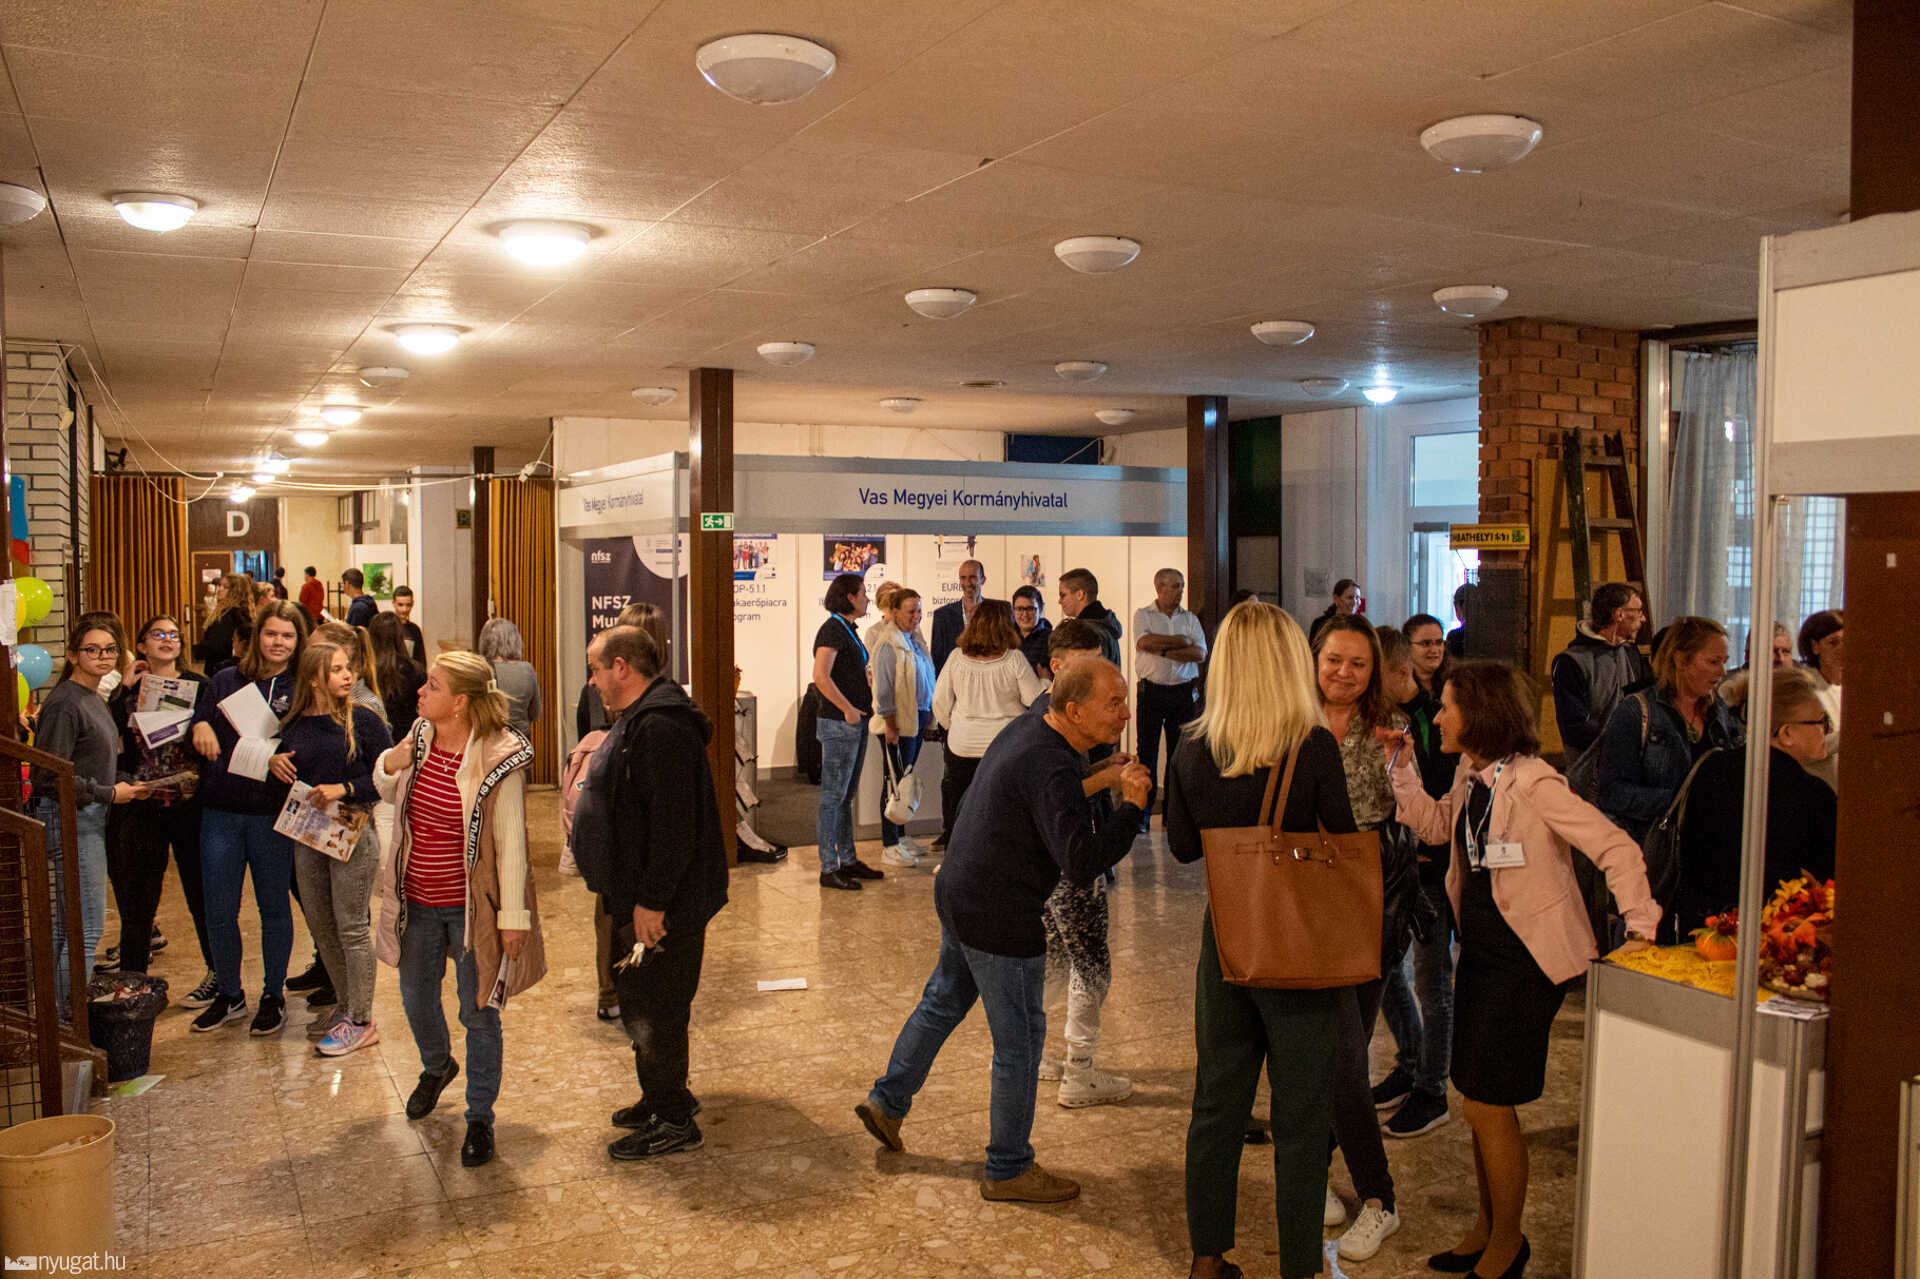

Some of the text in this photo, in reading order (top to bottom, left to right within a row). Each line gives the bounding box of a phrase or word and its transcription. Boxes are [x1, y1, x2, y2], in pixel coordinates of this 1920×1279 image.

[859, 487, 1068, 511] Vas Megyei Kormányhivatal
[226, 510, 251, 537] D
[591, 550, 611, 561] nfsz
[592, 595, 632, 610] NFSZ
[480, 784, 490, 797] IS
